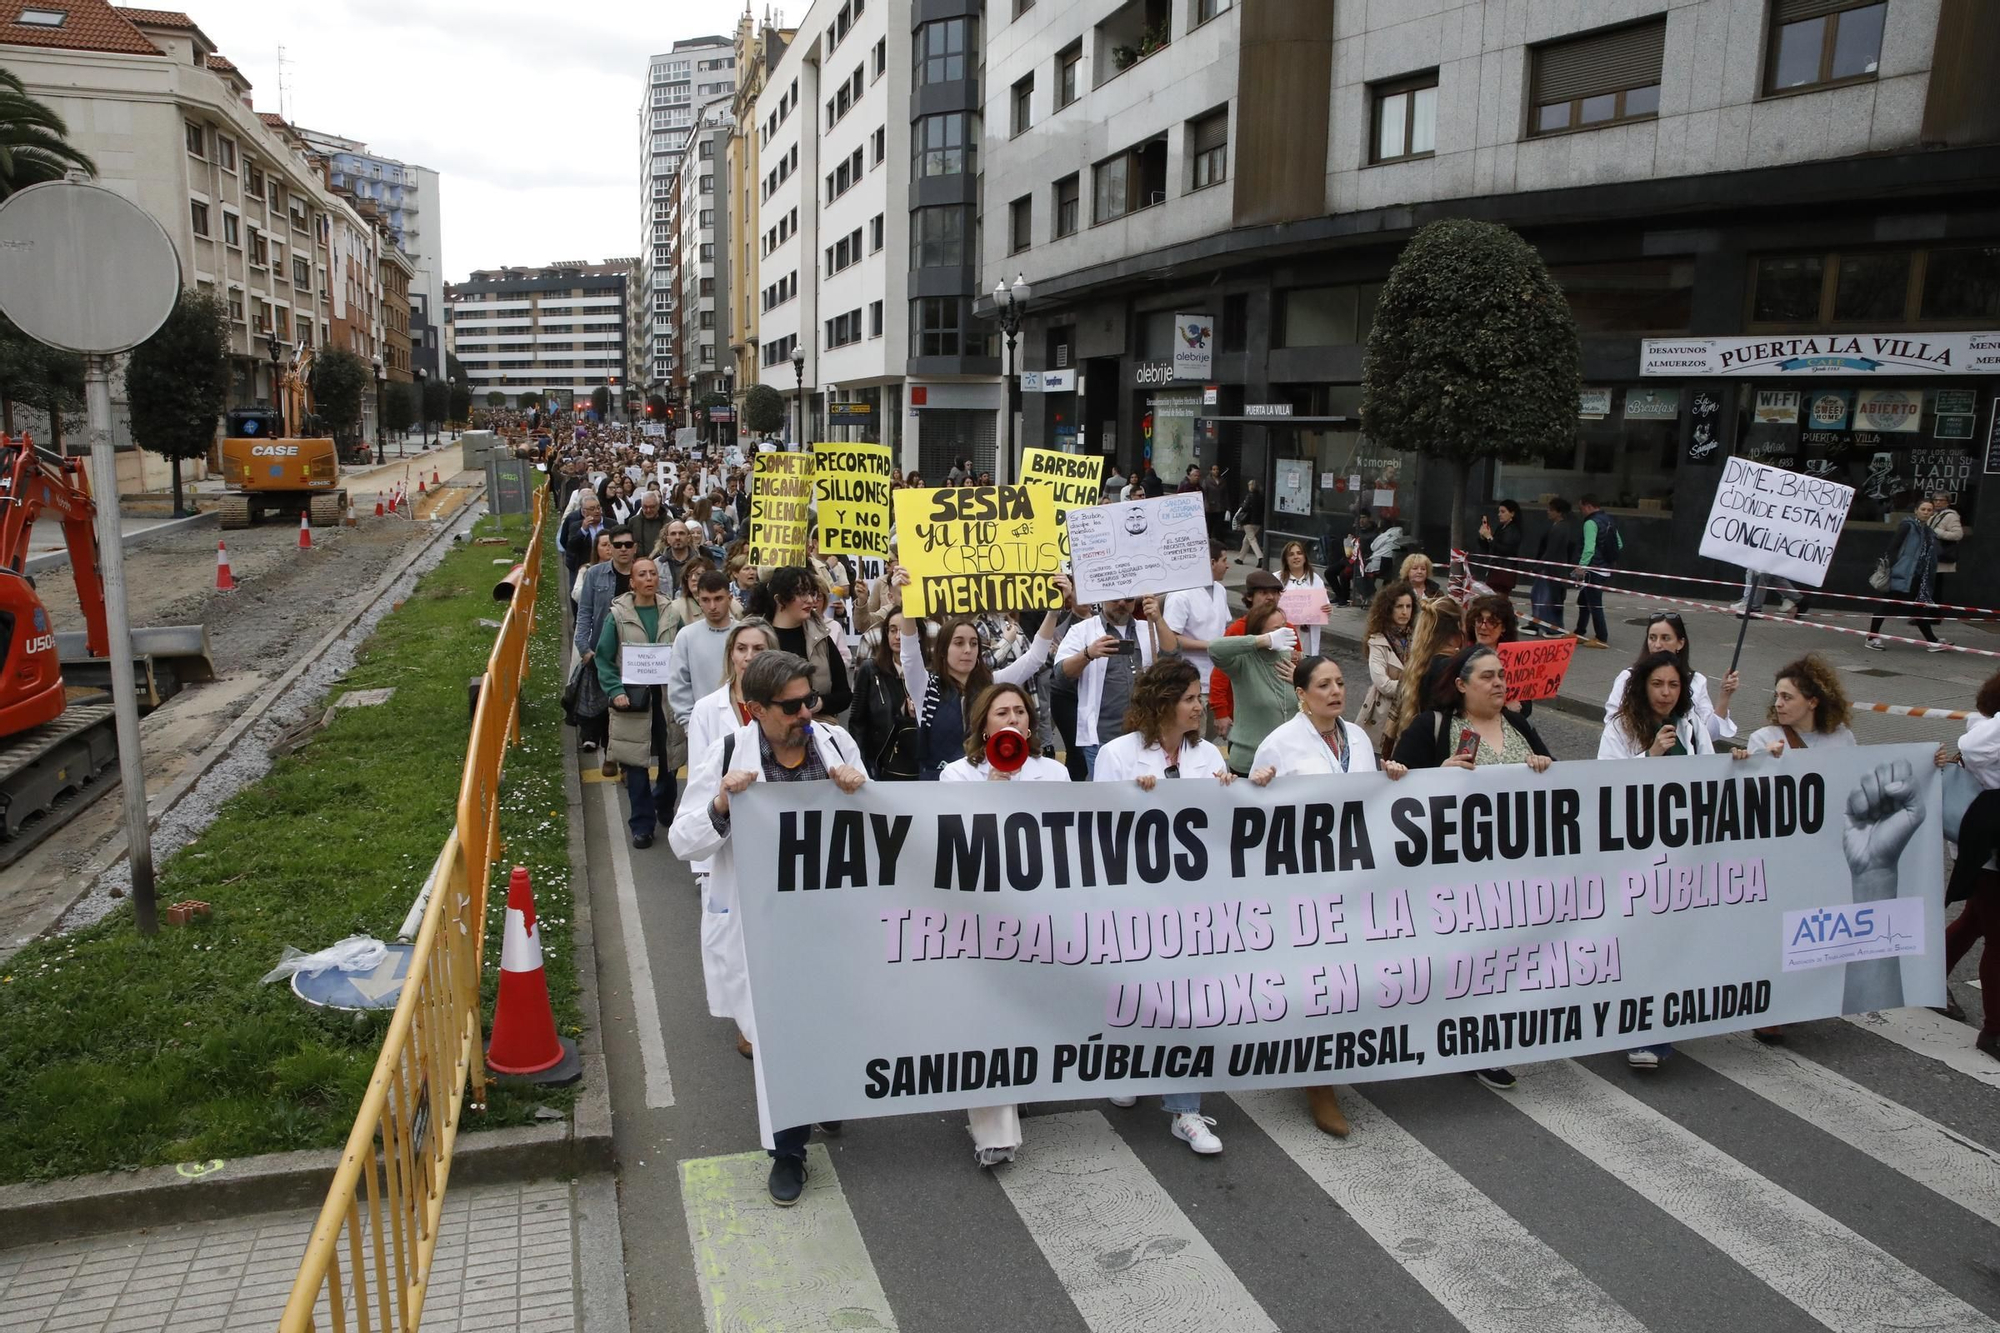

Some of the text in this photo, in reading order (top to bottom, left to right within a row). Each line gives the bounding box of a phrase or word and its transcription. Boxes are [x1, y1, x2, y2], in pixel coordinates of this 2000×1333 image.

[1176, 352, 1210, 363] alebrije
[1649, 346, 1707, 354] DESAYUNOS
[1719, 337, 1951, 368] PUERTA LA VILLA
[1136, 362, 1173, 386] alebrije
[1647, 360, 1707, 368] ALMUERZOS
[1246, 405, 1290, 416] PUERTA LA VILLA
[1627, 400, 1676, 414] Breakfast
[1760, 392, 1798, 407] WI-FI
[1814, 406, 1845, 415] SWEET
[1859, 402, 1917, 415] ABIERTO
[1802, 432, 1839, 443] PUERTA
[1854, 433, 1881, 443] VILLA
[252, 446, 299, 456] CASE
[1910, 455, 1973, 466] SACAN SU
[1931, 448, 1946, 456] LOS
[815, 452, 891, 477] RECORTAD
[1032, 456, 1100, 480] BARBÓN
[1914, 464, 1970, 478] LADO
[1725, 460, 1774, 495] DIME,
[1913, 478, 1967, 492] MAGNI
[816, 474, 889, 507] SILLONES
[930, 486, 1034, 522] SESPA
[836, 510, 881, 528] Y NO
[1781, 505, 1824, 529] ESTÁ
[1824, 513, 1845, 534] MI
[826, 528, 889, 555] PEONES
[916, 522, 999, 553] ya no
[1710, 516, 1834, 567] CONCILIACIÓN?
[943, 544, 1005, 574] CREO
[1004, 542, 1059, 573] TUS
[928, 575, 1064, 614] MENTIRAS
[1514, 650, 1531, 667] NO
[1533, 643, 1573, 665] SABES
[778, 772, 1826, 892] HAY MOTIVOS PARA SEGUIR LUCHANDO
[880, 853, 1768, 966] TRABAJADORXS DE LA SANIDAD PÚBLICA
[1792, 908, 1874, 946] ATAS
[1104, 936, 1622, 1029] UNIDXS EN SU DEFENSA
[864, 980, 1772, 1099] SANIDAD PÚBLICA UNIVERSAL, GRATUITA Y DE CALIDAD
